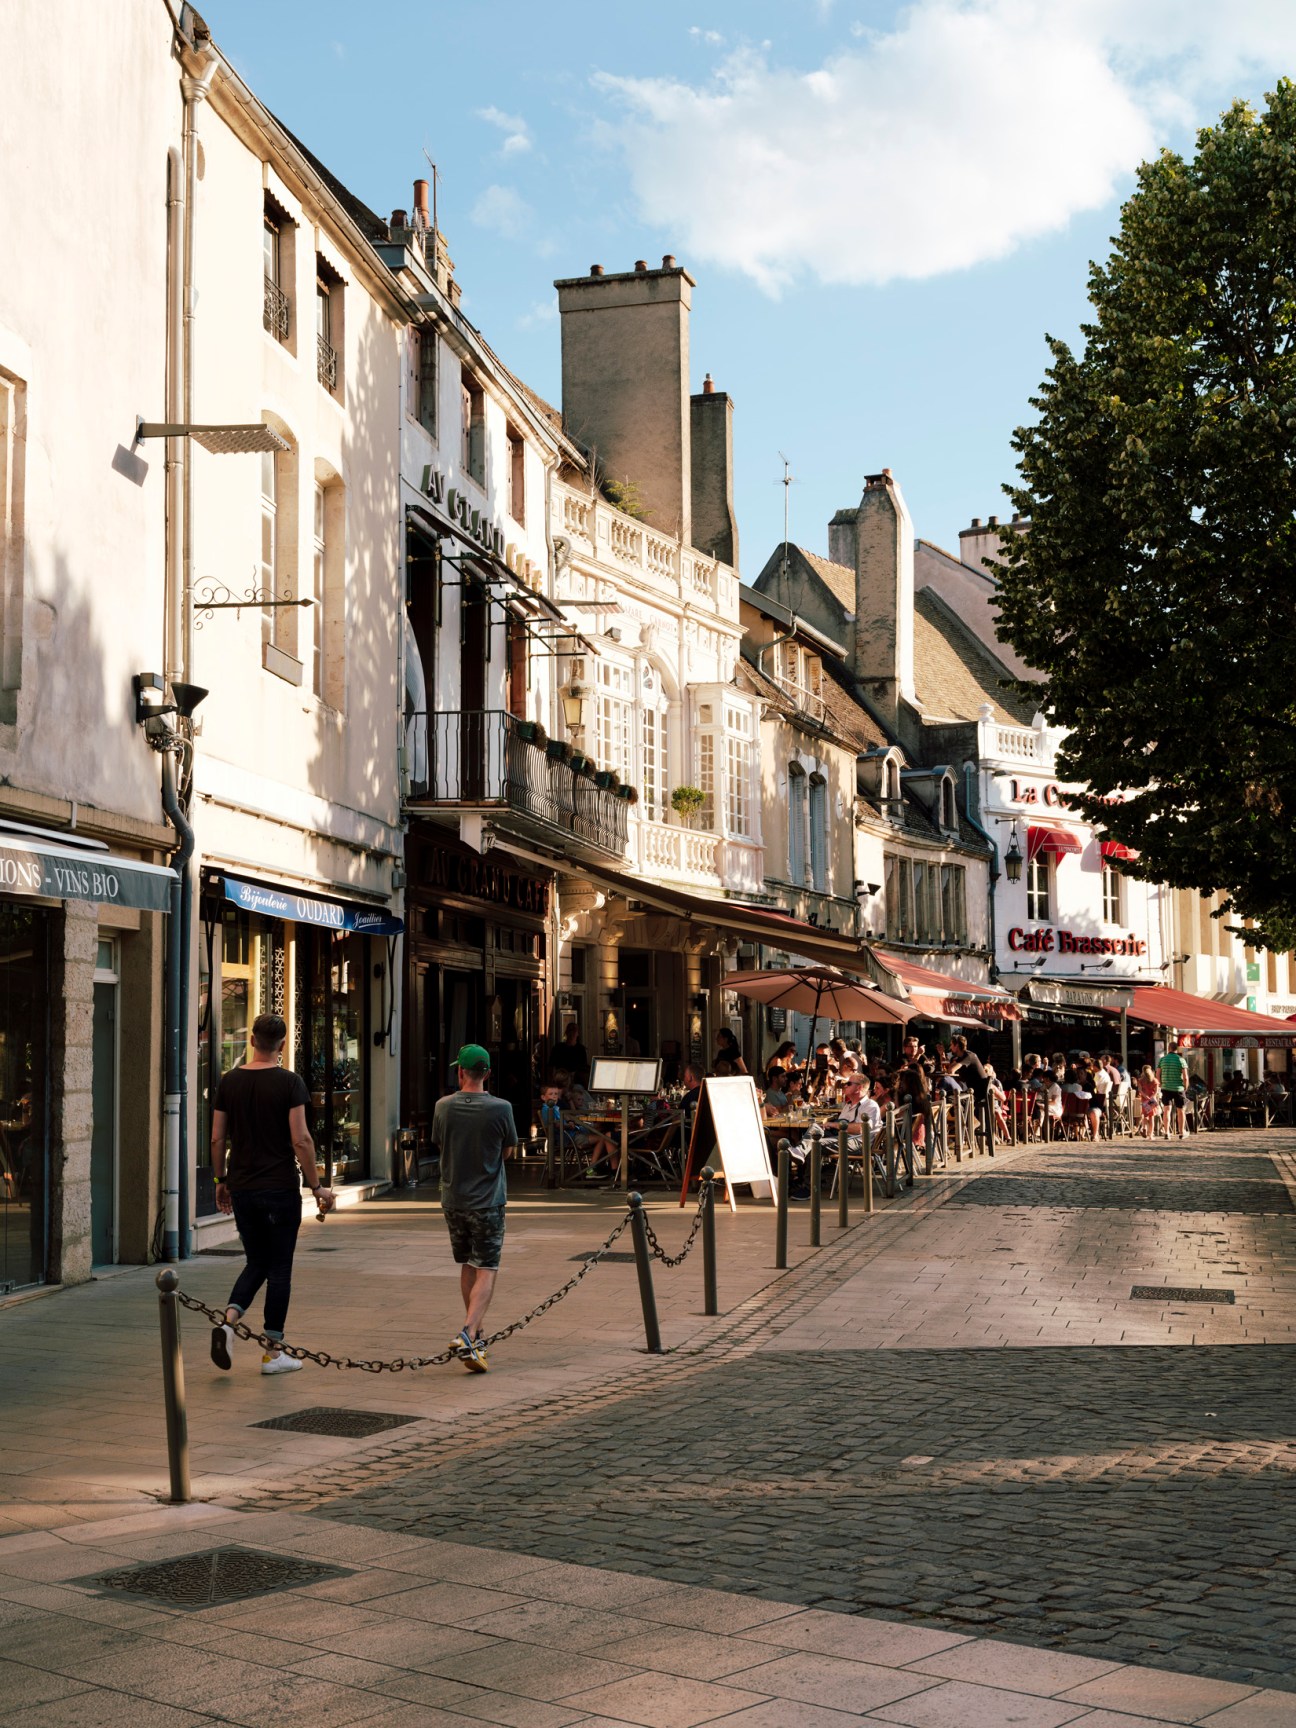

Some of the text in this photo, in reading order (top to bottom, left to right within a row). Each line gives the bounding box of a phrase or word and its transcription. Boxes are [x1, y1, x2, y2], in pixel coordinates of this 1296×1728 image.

[448, 488, 505, 558] GRAND
[1010, 779, 1038, 804] La
[0, 858, 42, 888] IONS
[54, 868, 90, 895] VINS
[93, 872, 119, 898] BIO
[239, 885, 288, 911] Bijouterie
[296, 897, 345, 927] OUDARD
[1008, 927, 1147, 956] Café Brasserie
